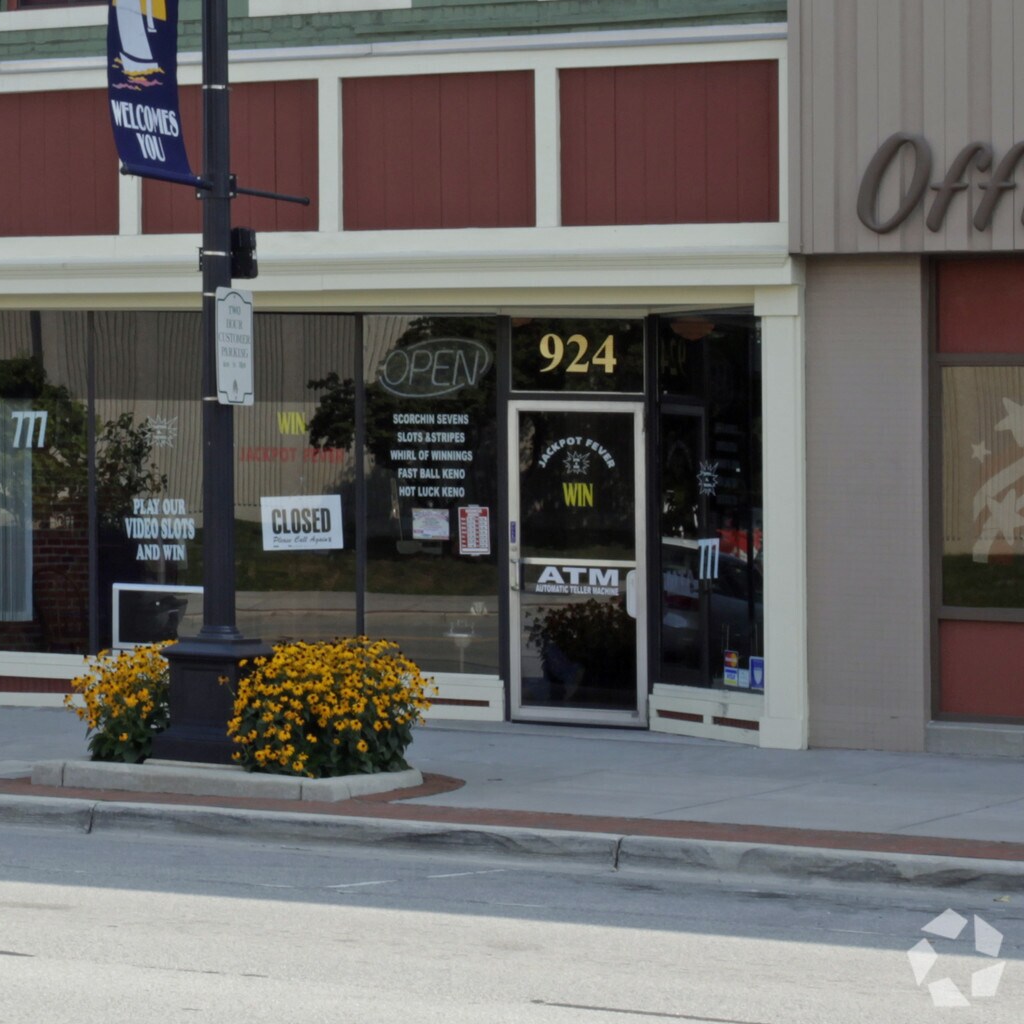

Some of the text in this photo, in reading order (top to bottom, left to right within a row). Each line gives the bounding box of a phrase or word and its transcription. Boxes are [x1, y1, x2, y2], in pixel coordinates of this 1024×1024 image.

[111, 99, 180, 138] WELCOMES
[136, 133, 166, 163] YOU
[857, 131, 1024, 235] Off
[228, 305, 241, 315] TWO
[226, 319, 243, 330] HOUR
[218, 332, 251, 345] CUSTOMER
[221, 346, 249, 359] PARKING
[539, 333, 618, 374] 924
[383, 349, 480, 387] OPEN
[277, 411, 306, 435] WIN
[393, 413, 469, 425] SCORCHIN SEVENS
[397, 432, 424, 443] SLOTS
[239, 447, 345, 465] JACKPOT FEVER
[390, 449, 473, 462] WHIRL OF WINNINGS
[538, 437, 616, 469] JACKPOT FEVER
[397, 468, 466, 480] FAST BALL KENO
[398, 486, 465, 498] HOT LUCK KENO
[562, 482, 593, 507] WIN
[133, 497, 185, 515] PLAY OUR
[125, 517, 195, 540] VIDEO SLOTS
[271, 507, 332, 535] CLOSED
[136, 544, 185, 561] AND WIN
[536, 565, 619, 587] ATM
[536, 584, 619, 596] AUTOMATIC TELLER MACHINE
